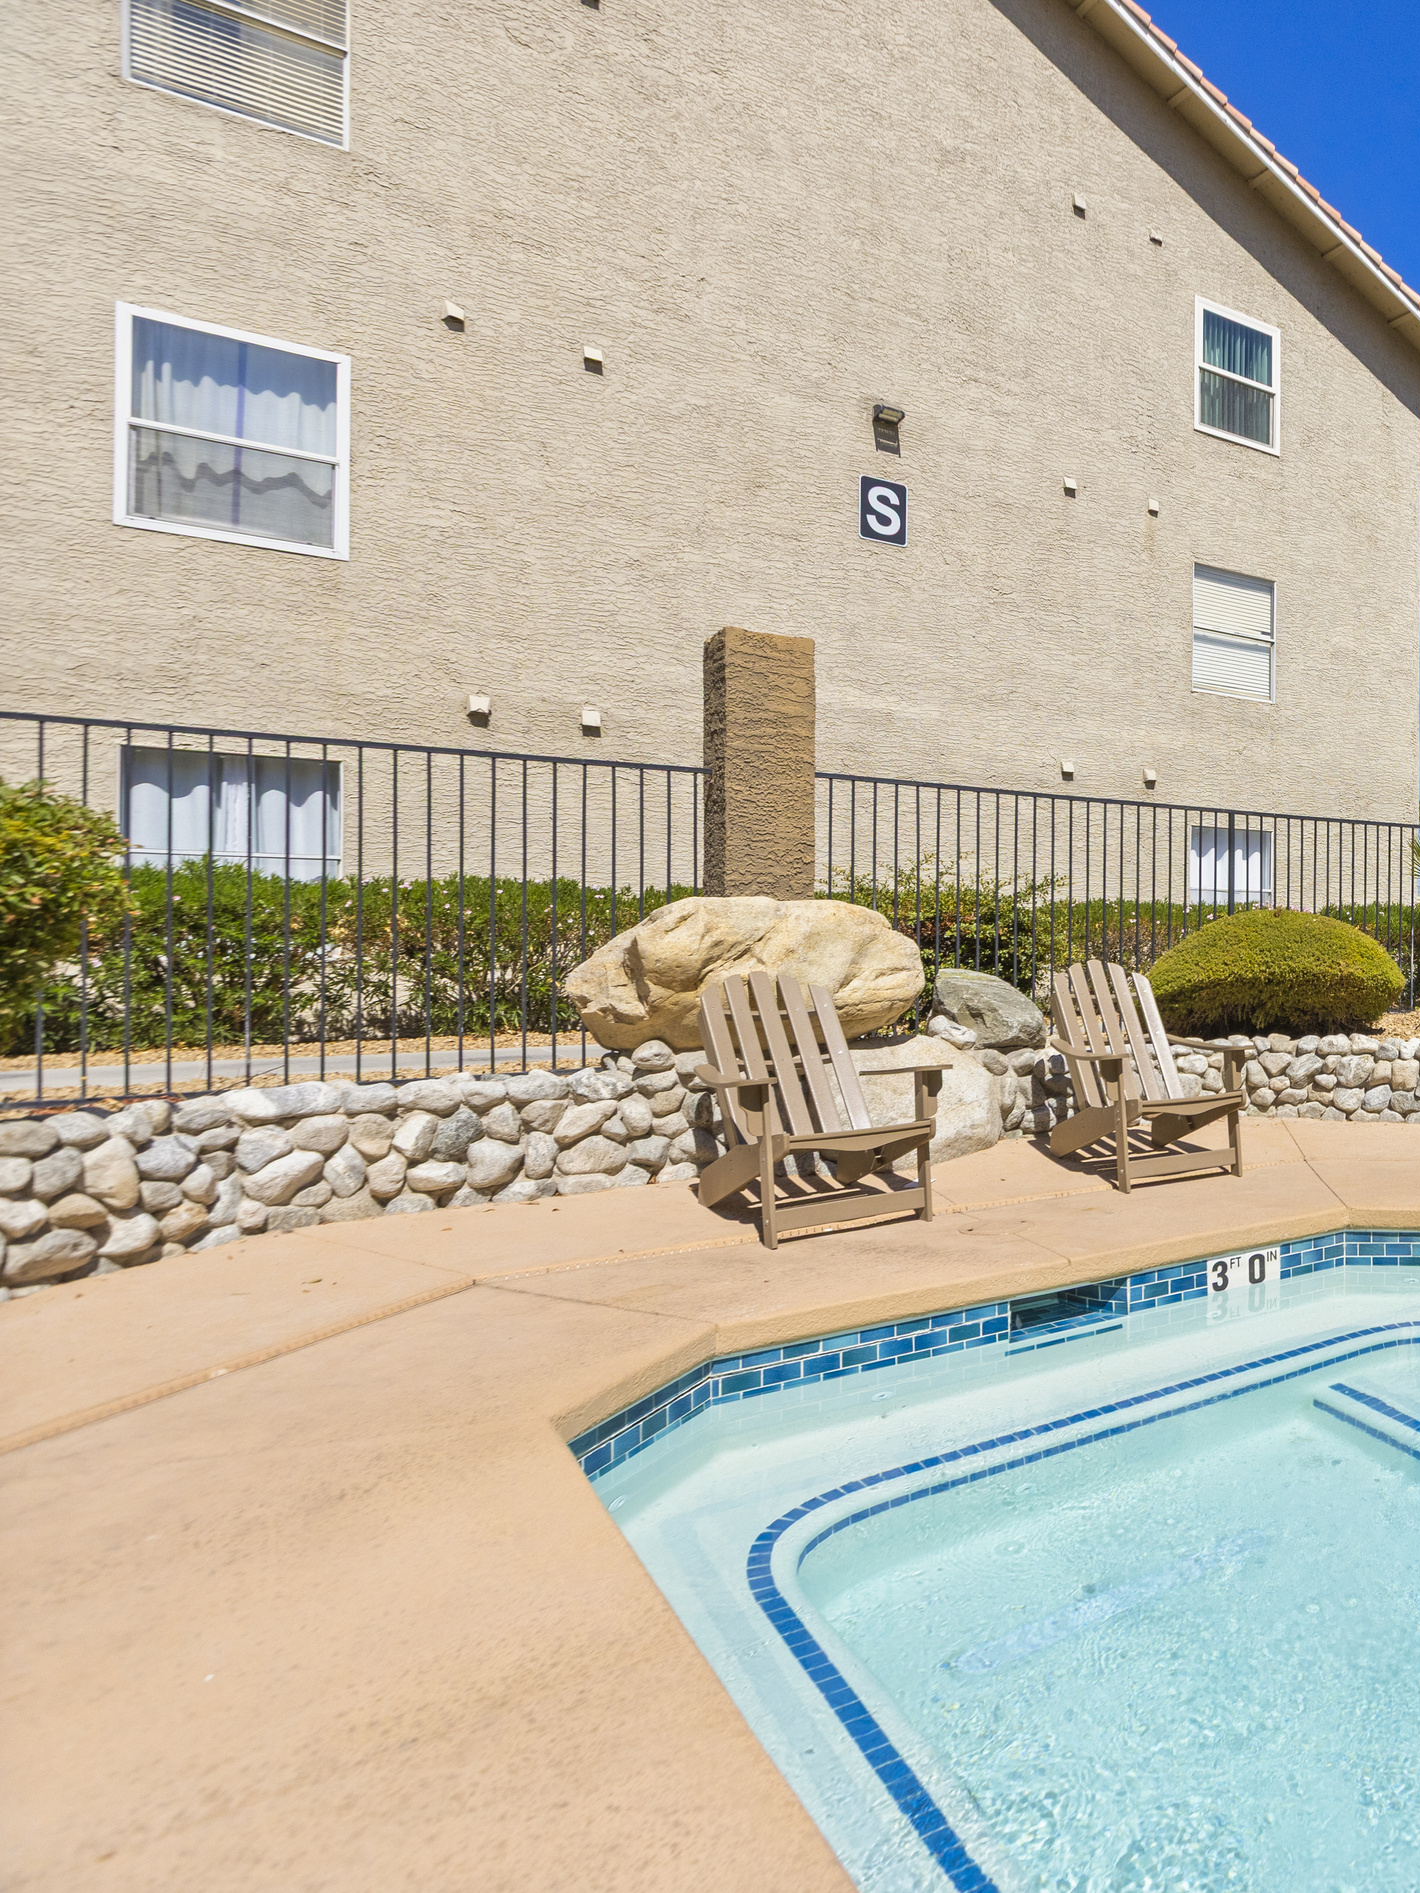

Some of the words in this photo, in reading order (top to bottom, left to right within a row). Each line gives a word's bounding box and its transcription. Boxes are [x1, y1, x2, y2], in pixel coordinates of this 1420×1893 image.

[866, 486, 901, 536] S
[1212, 1260, 1229, 1292] 3
[1230, 1256, 1242, 1269] FT
[1248, 1253, 1266, 1284] 0
[1266, 1249, 1277, 1262] IN
